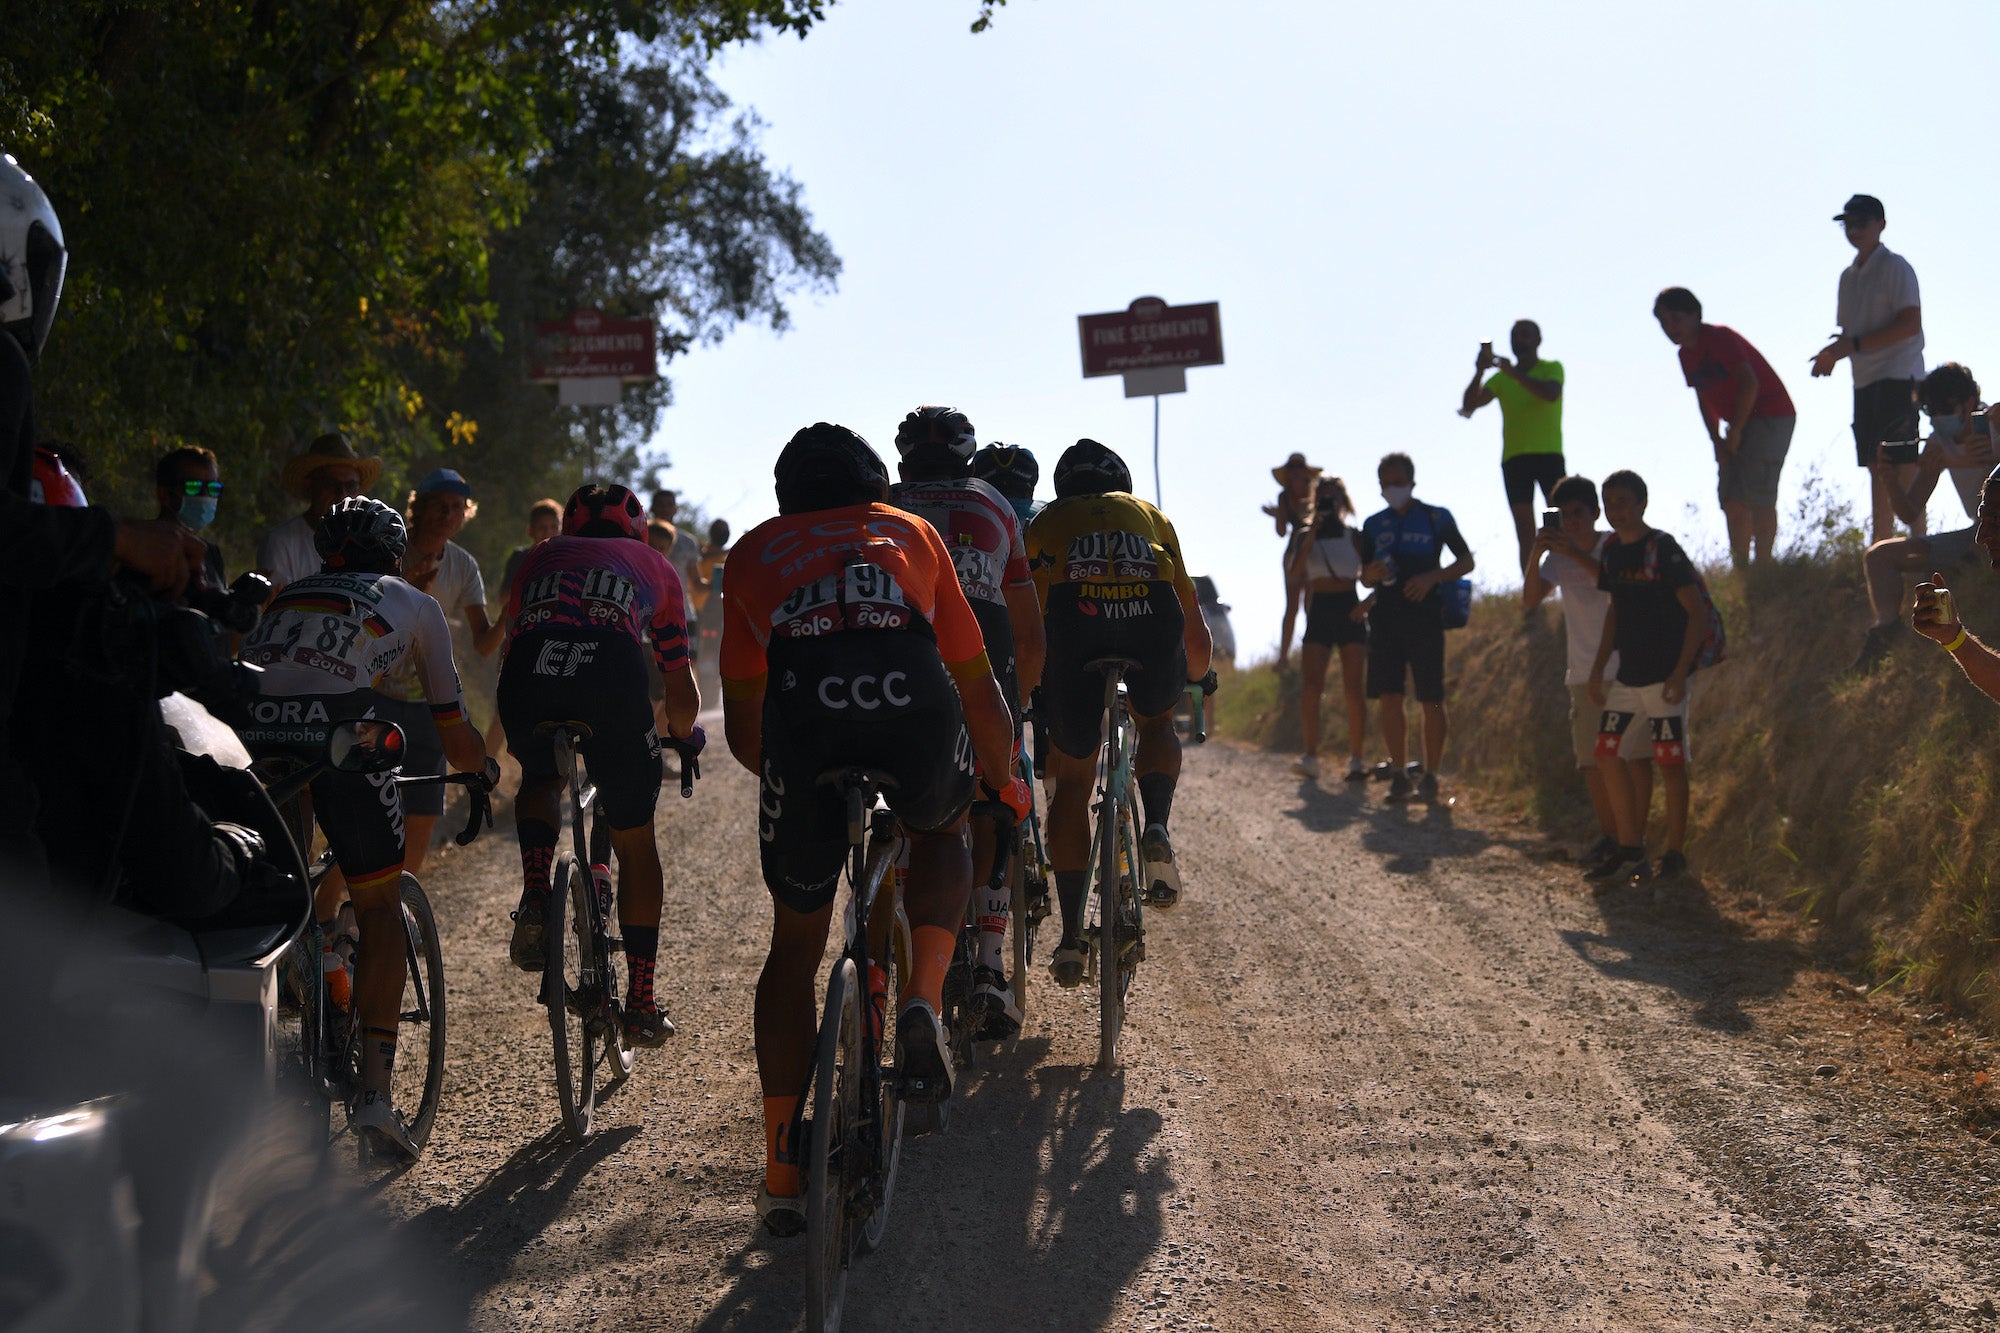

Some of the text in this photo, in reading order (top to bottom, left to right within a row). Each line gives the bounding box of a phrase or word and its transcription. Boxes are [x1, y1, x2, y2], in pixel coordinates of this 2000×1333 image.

[1092, 318, 1208, 346] FINE SEGMENTO
[1068, 532, 1108, 561] 201
[586, 569, 633, 606] 111
[855, 566, 892, 600] 91
[1078, 583, 1149, 599] JUMBO
[1103, 600, 1153, 619] VISMA
[316, 616, 361, 659] 87
[817, 670, 912, 711] CCC
[635, 957, 647, 999] ARGYLE
